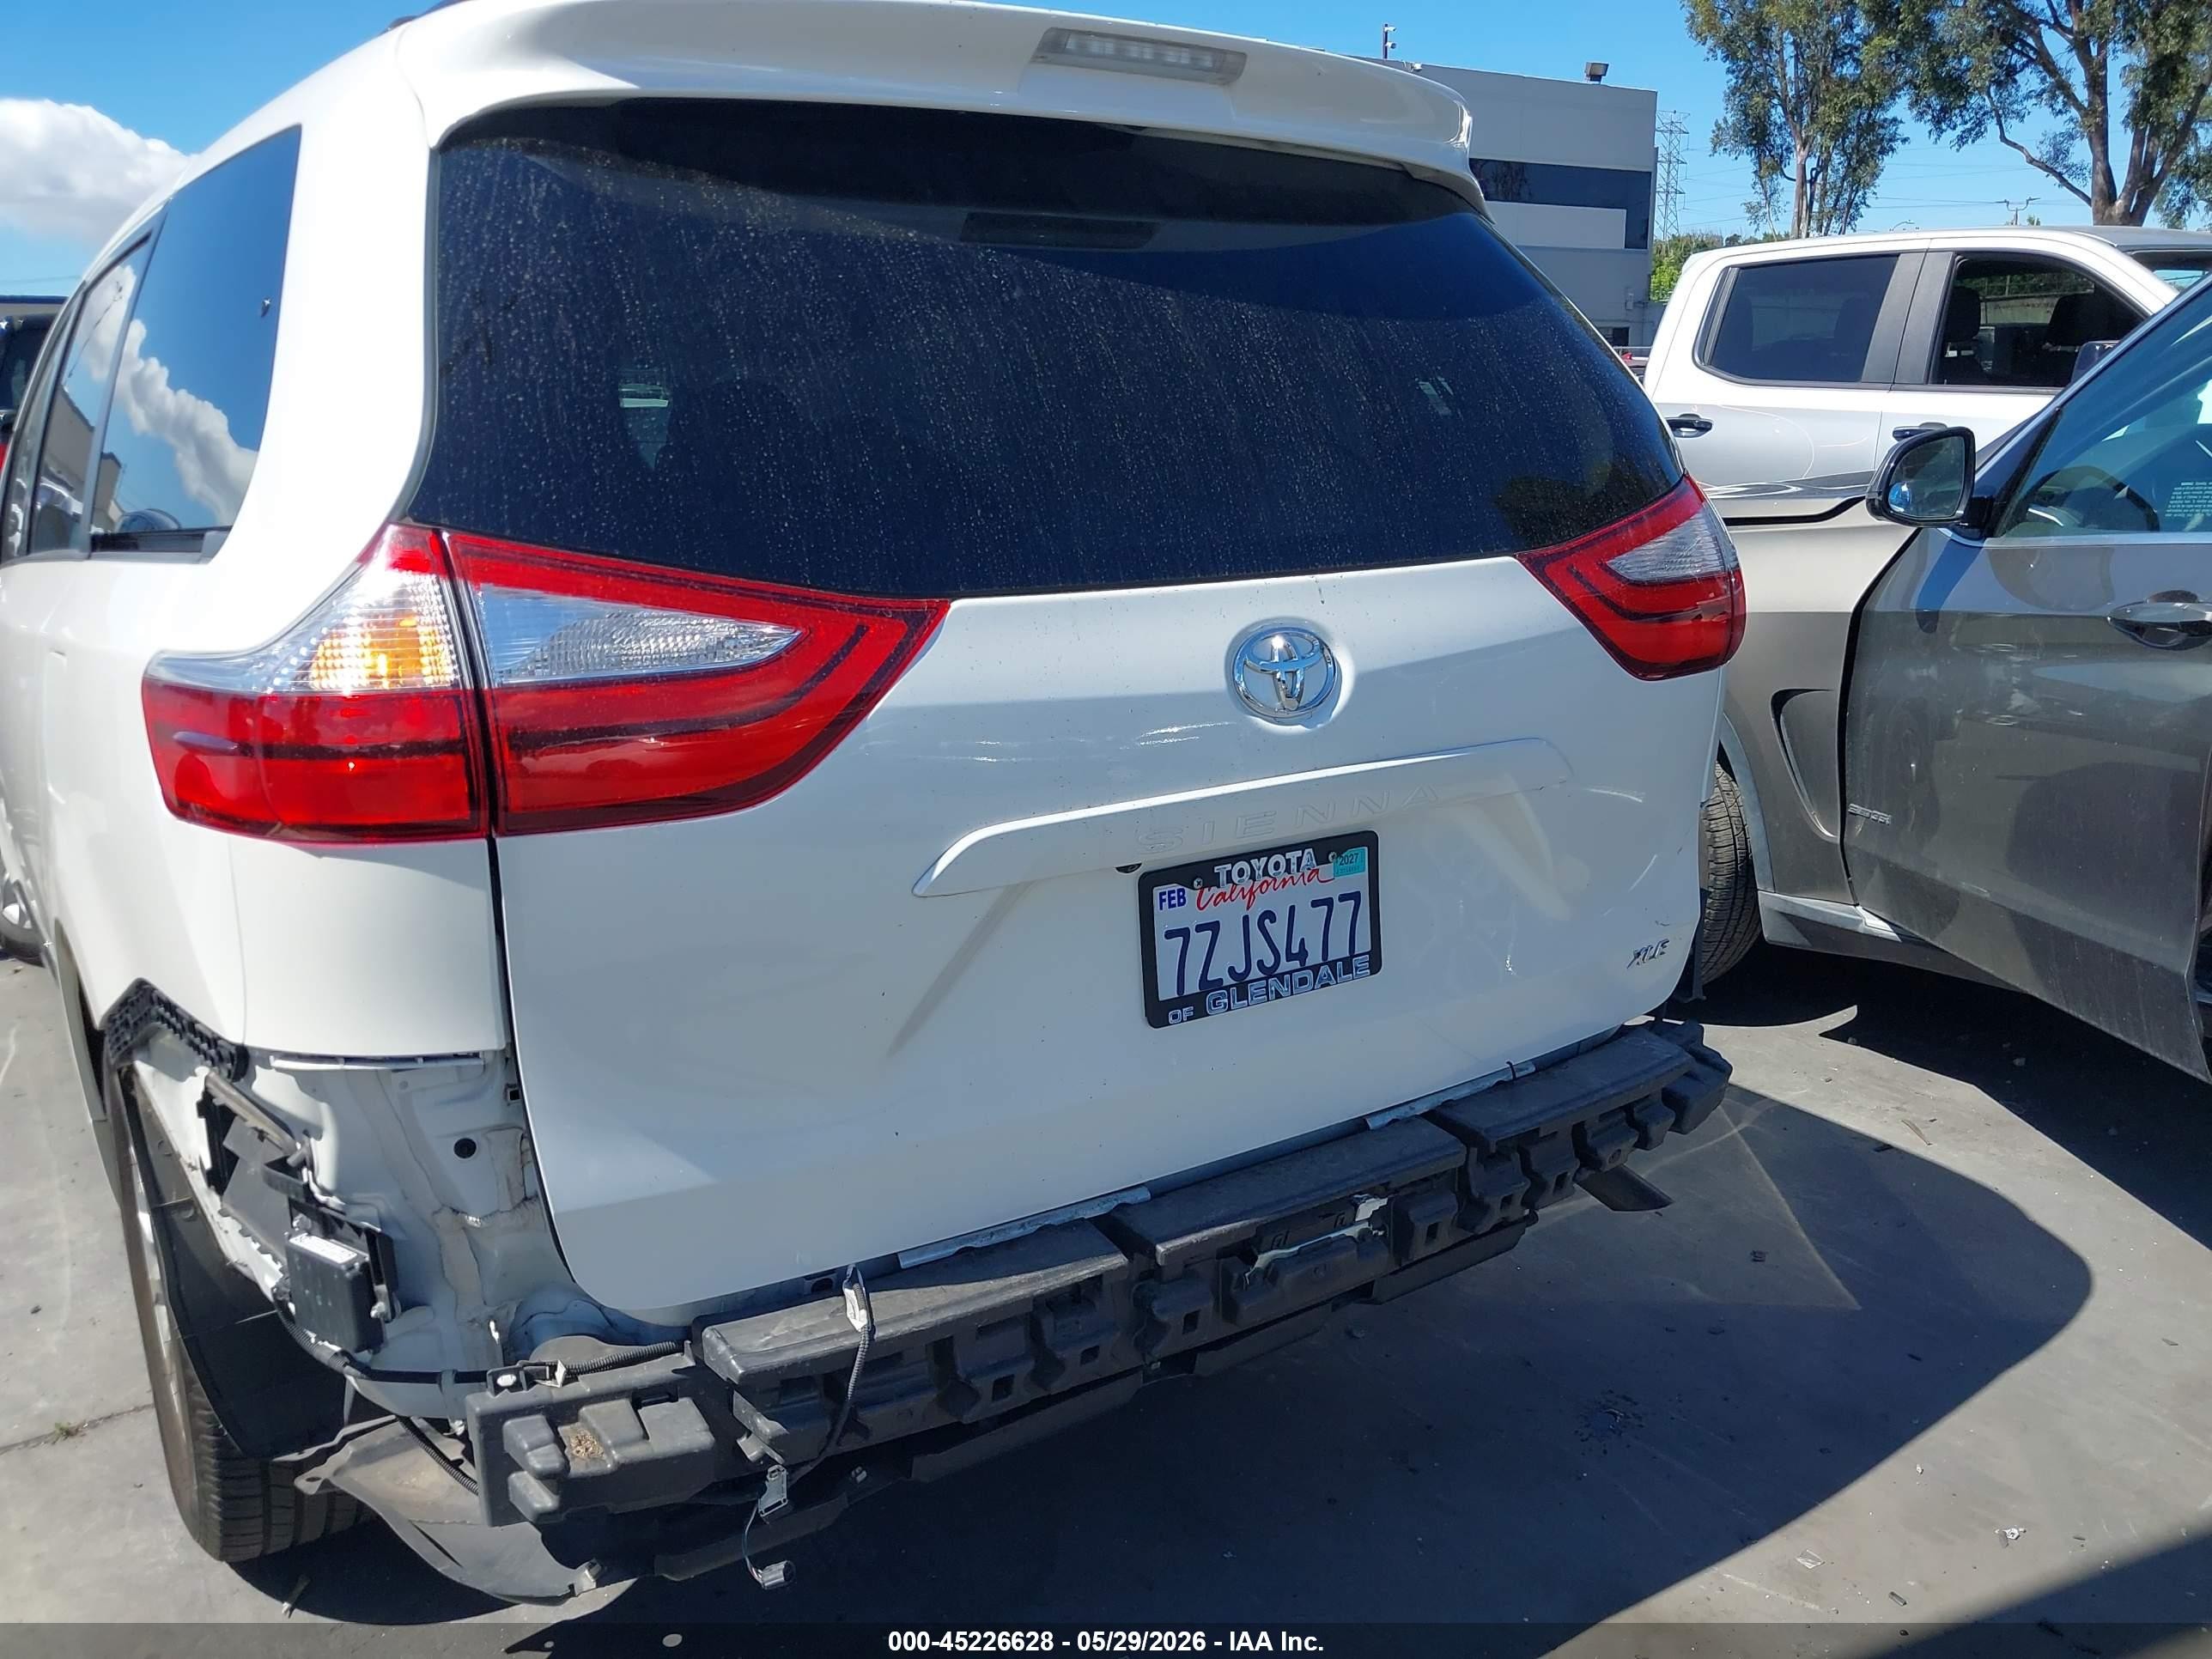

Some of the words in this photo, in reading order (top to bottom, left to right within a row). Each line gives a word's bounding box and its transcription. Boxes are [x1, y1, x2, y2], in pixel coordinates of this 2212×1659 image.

[1137, 782, 1443, 854] SIENNA
[1214, 848, 1317, 888] TOYOTA
[1339, 852, 1359, 866] 2027
[1158, 887, 1187, 911] FEB
[1196, 868, 1334, 911] California
[1164, 890, 1362, 996] 7ZJS477
[1168, 1006, 1194, 1024] OF
[1206, 954, 1370, 1016] GLENDALE
